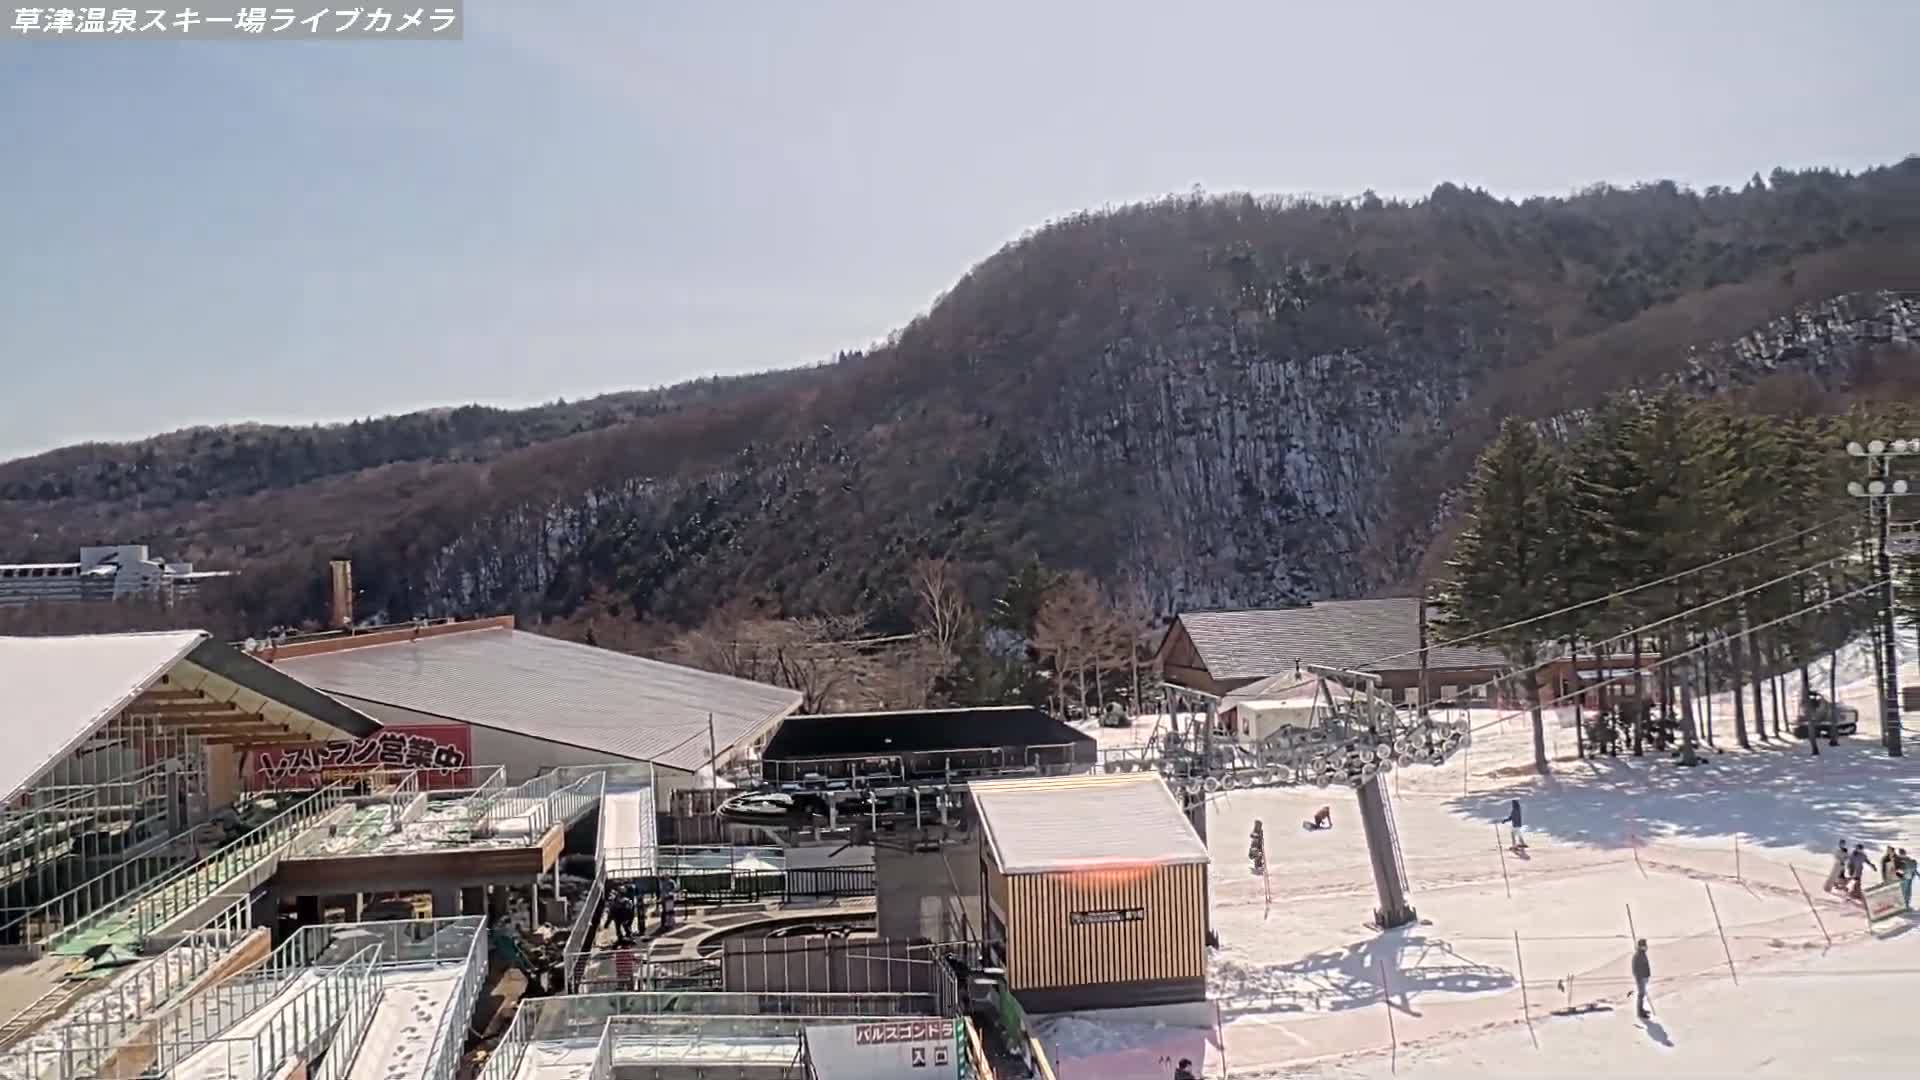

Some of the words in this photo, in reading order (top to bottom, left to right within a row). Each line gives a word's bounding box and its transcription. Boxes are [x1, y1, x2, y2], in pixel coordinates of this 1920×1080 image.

[260, 733, 464, 783] レストラン営業中
[913, 1050, 948, 1065] 入口
